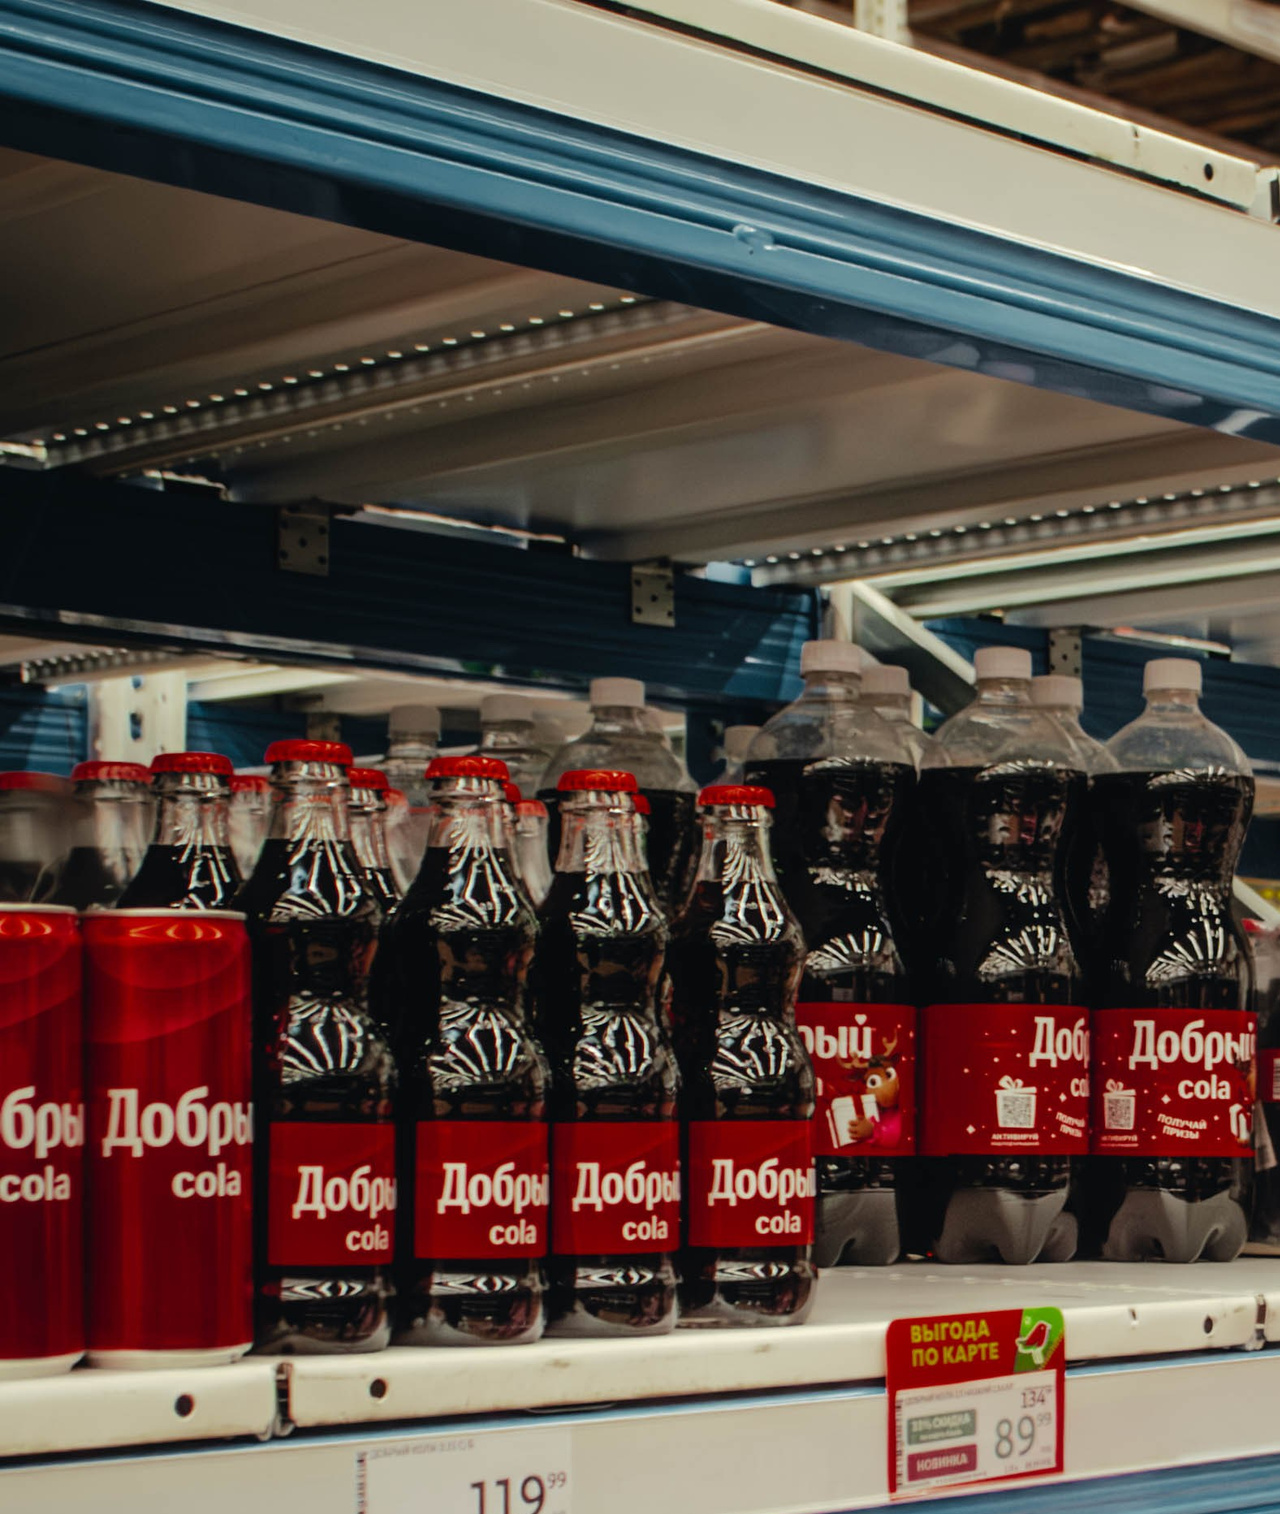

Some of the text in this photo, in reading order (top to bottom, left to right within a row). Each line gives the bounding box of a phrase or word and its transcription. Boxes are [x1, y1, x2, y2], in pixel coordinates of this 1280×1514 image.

[798, 1014, 873, 1060] рый
[1029, 1016, 1090, 1068] Доб
[1178, 1074, 1231, 1099] cola
[0, 1086, 84, 1159] бры
[102, 1086, 254, 1158] Добры
[1157, 1113, 1207, 1131] ПОЛУЧАЙ
[1163, 1125, 1199, 1140] ПРИЗЫ
[0, 1165, 71, 1202] cola
[172, 1162, 242, 1198] cola
[292, 1164, 397, 1219] Добры
[437, 1162, 550, 1214] Добры
[572, 1160, 681, 1212] Добры
[346, 1224, 389, 1251] cola
[489, 1218, 537, 1245] cola
[622, 1215, 668, 1241] cola
[755, 1210, 802, 1234] cola
[910, 1319, 990, 1343] ВЫГОДА
[912, 1342, 999, 1367] ПО КАРТЕ
[995, 1415, 1036, 1459] 89
[916, 1453, 968, 1473] НОВИНКА
